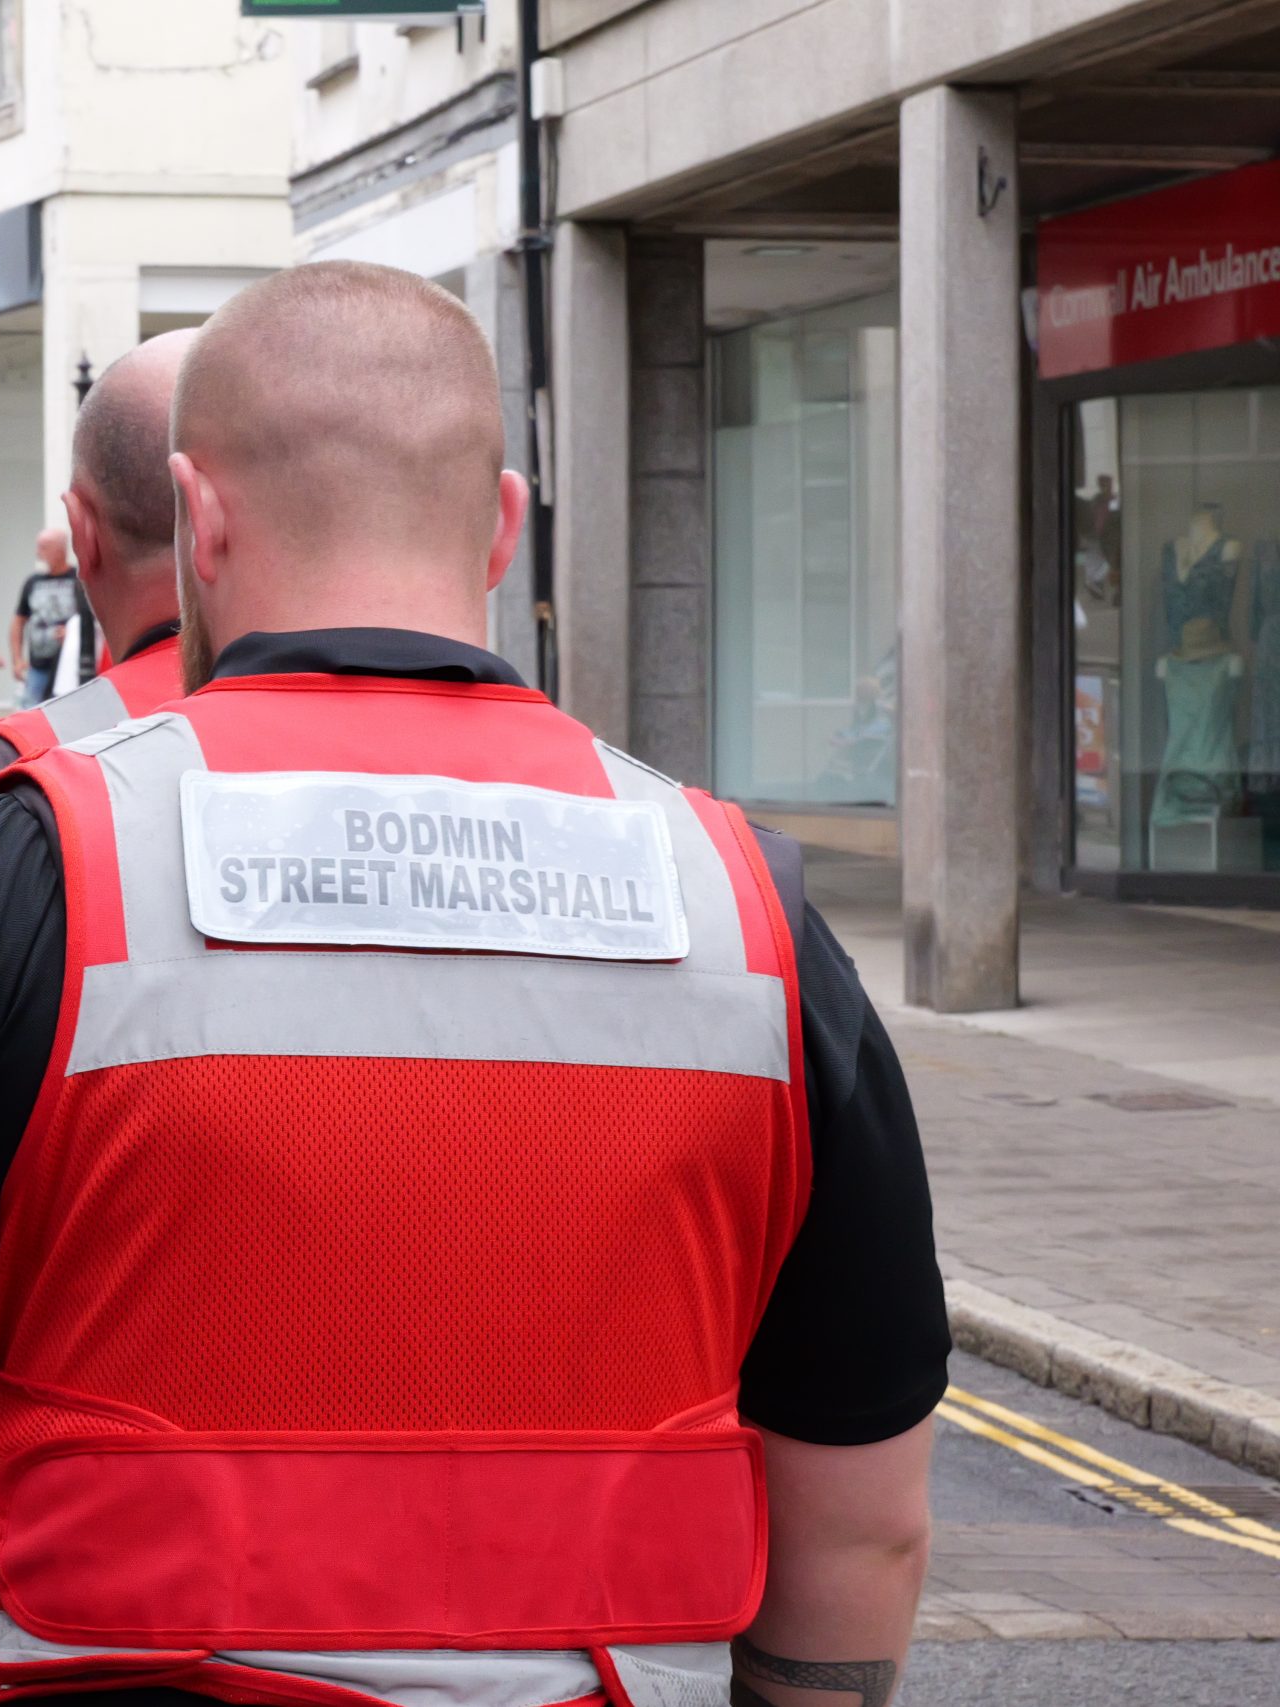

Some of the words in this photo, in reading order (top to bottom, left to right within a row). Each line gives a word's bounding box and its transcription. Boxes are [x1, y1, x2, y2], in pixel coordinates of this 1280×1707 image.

[1131, 261, 1162, 310] Air
[1165, 242, 1280, 304] Ambulance
[344, 809, 524, 863] BODMIN
[220, 857, 396, 907] STREET
[409, 861, 654, 923] MARSHALL
